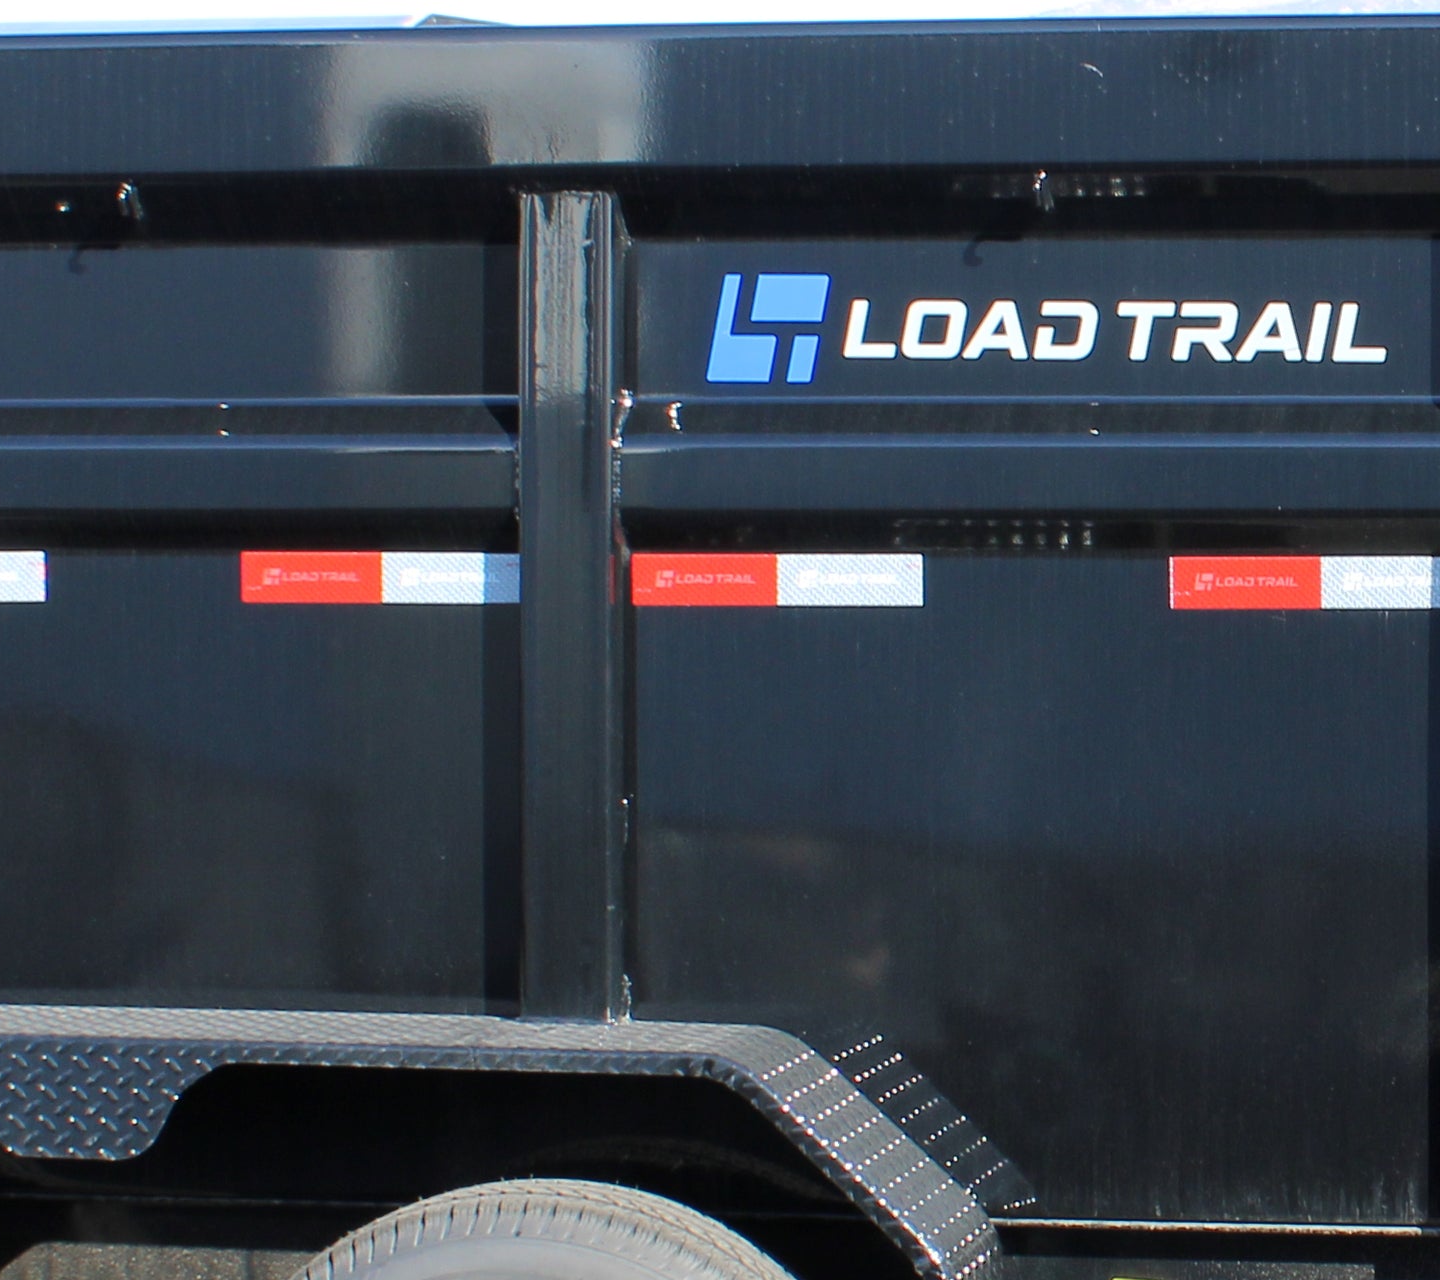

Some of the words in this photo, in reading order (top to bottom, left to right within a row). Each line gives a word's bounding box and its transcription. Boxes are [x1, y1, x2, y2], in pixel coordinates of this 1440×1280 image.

[841, 297, 1100, 362] LOAD
[1117, 299, 1388, 365] TRAIL
[1215, 575, 1254, 587] LOAD
[1255, 576, 1298, 588] TRAIL
